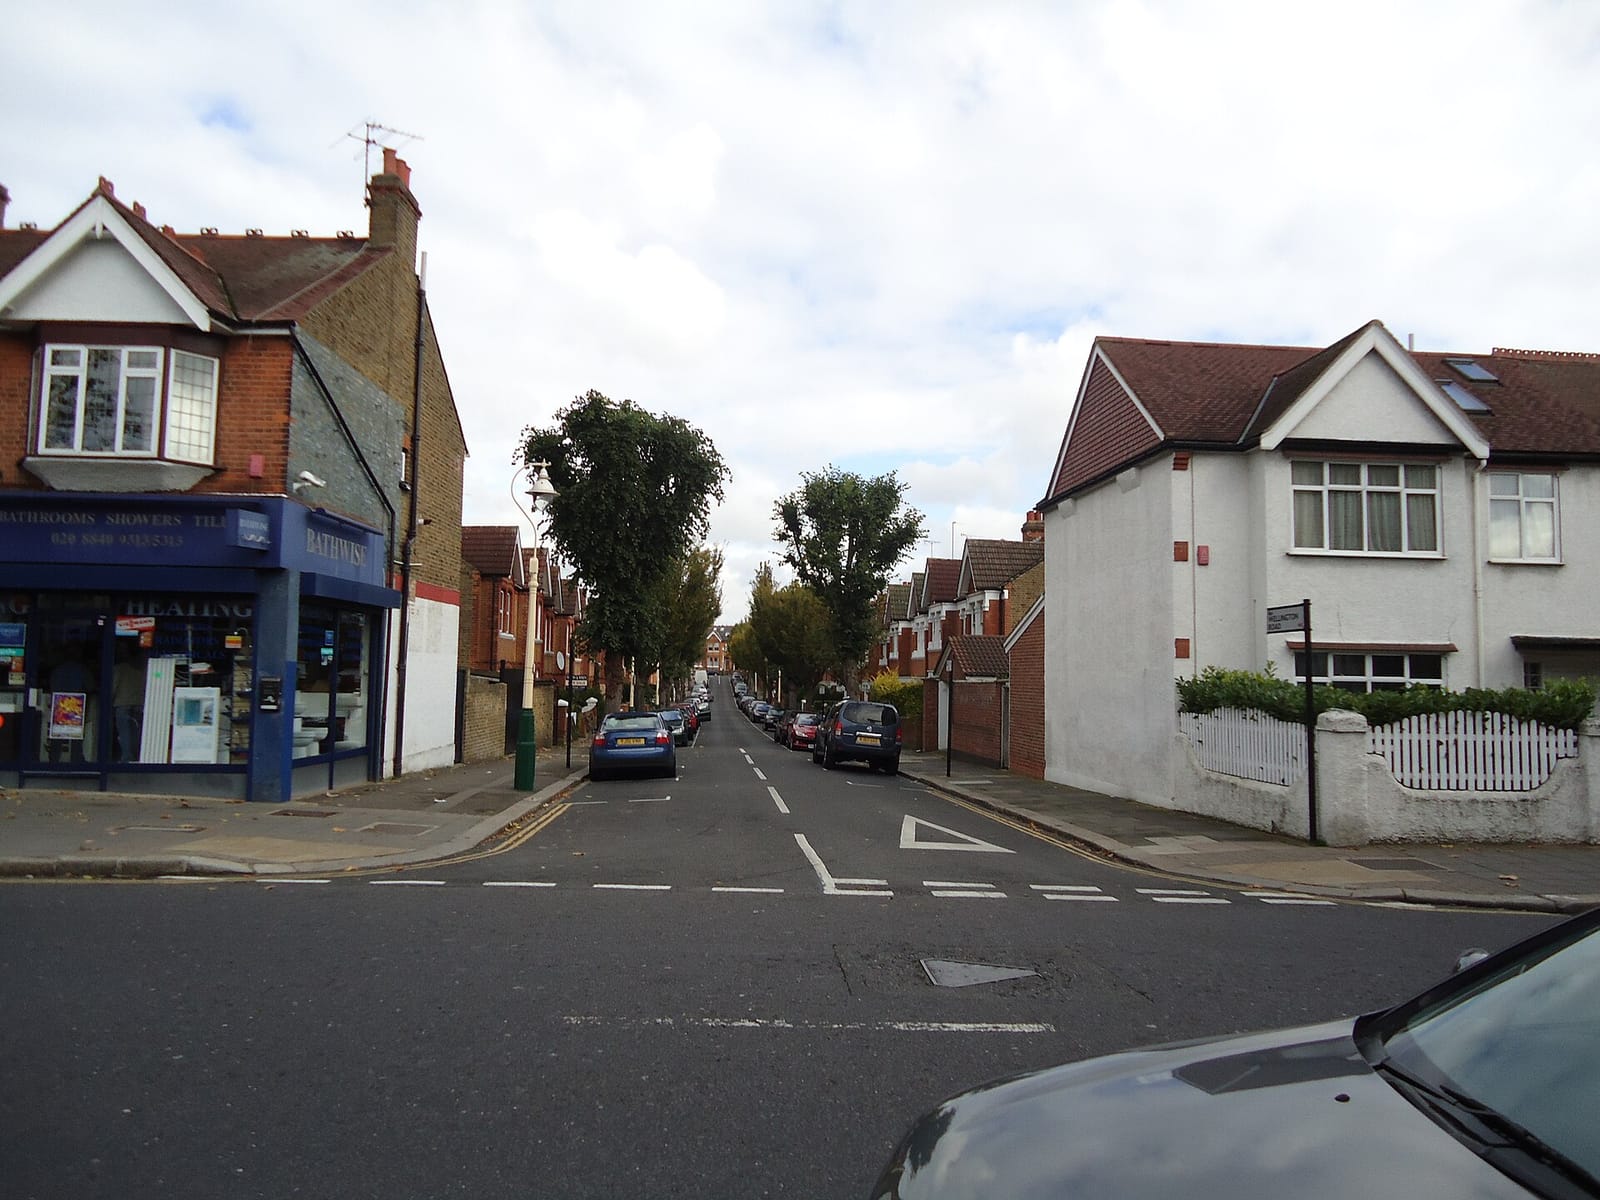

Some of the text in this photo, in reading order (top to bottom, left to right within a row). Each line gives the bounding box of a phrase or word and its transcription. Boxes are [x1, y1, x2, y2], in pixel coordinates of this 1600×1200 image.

[105, 512, 182, 527] SHOWERS
[305, 527, 368, 567] BATHWISE
[127, 599, 253, 618] HEATING
